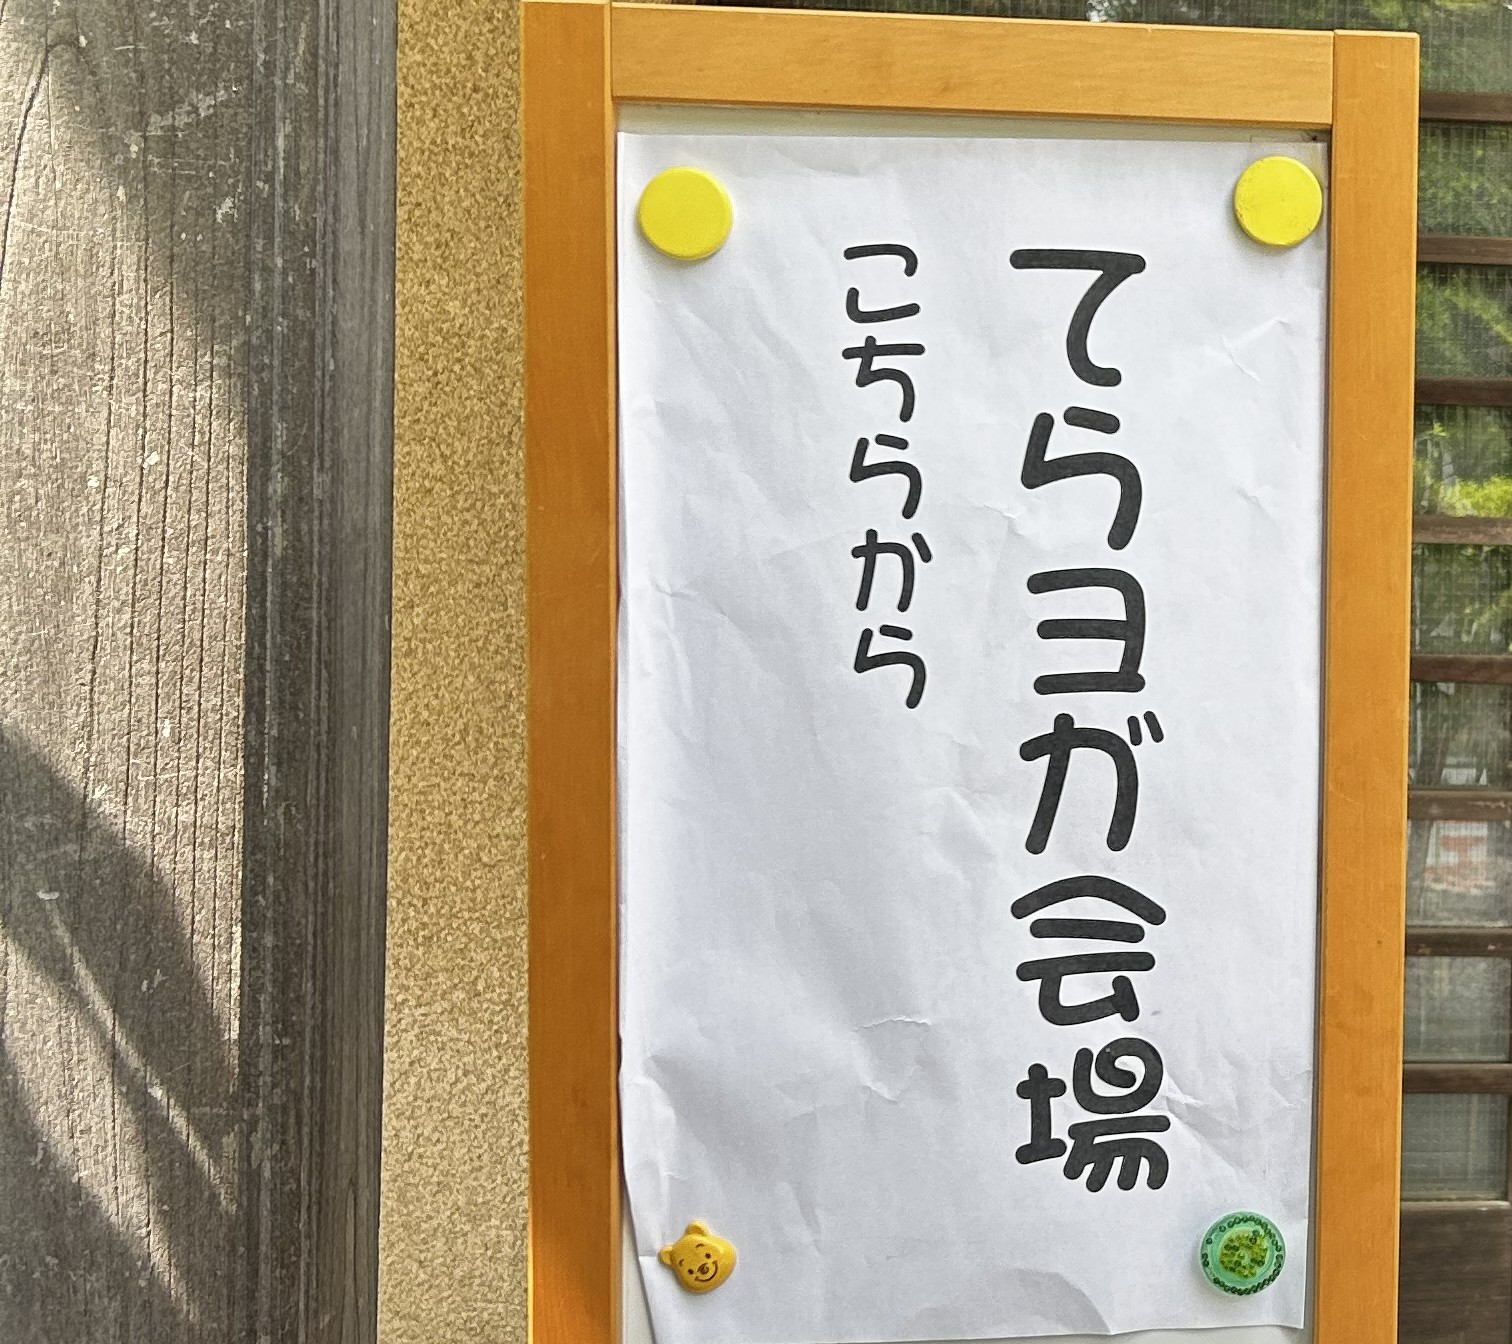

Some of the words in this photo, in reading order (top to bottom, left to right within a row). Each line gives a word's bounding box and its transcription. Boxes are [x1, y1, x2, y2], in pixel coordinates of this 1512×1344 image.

[840, 242, 933, 711] こちらから
[1007, 246, 1172, 1194] てらヨガ会場
